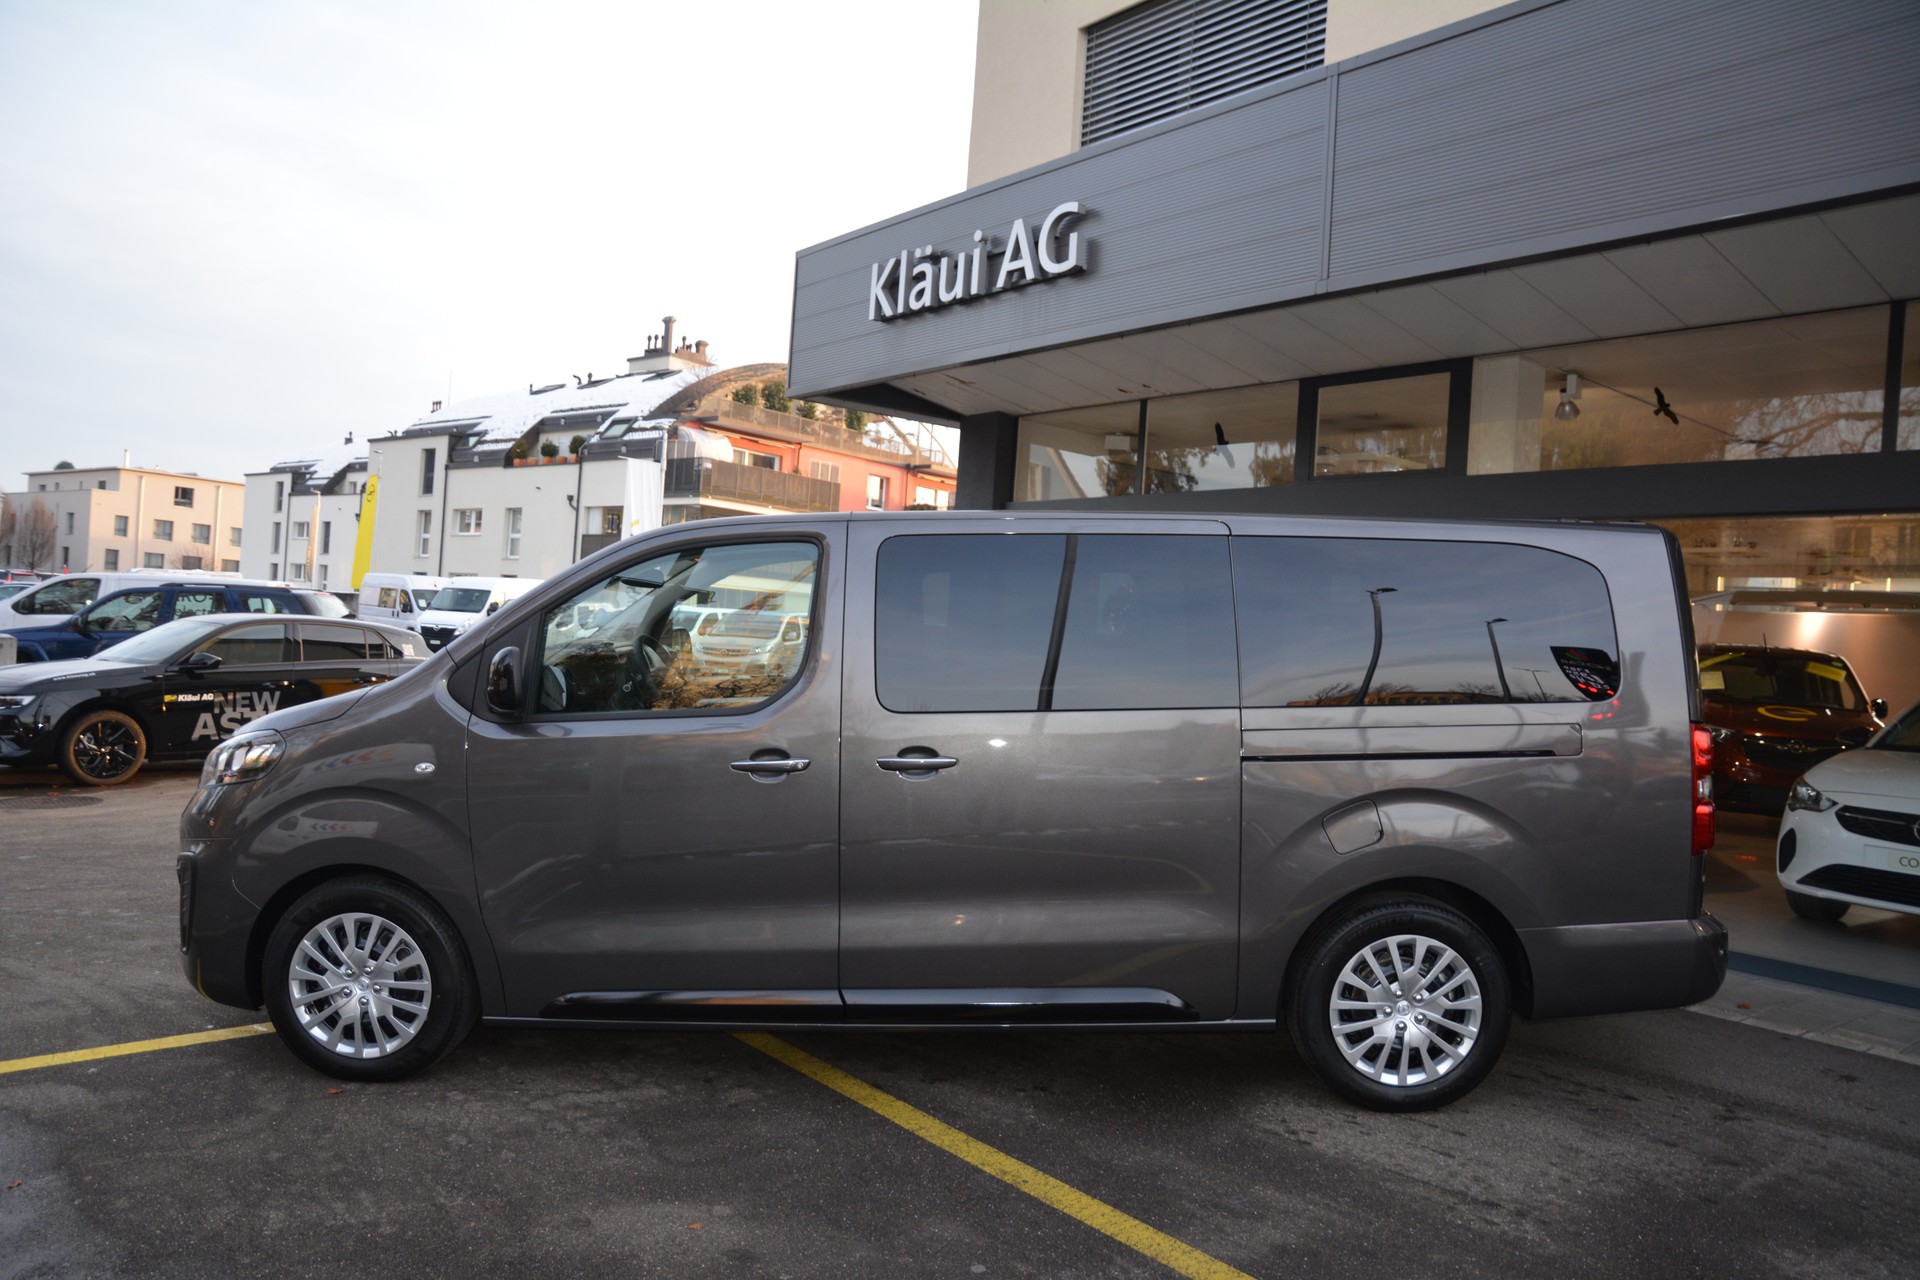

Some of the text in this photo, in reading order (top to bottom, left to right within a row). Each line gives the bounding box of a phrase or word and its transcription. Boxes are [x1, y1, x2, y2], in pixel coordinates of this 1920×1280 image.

[868, 201, 1088, 321] Kläui AG
[201, 693, 214, 701] AG
[214, 690, 281, 714] NEW
